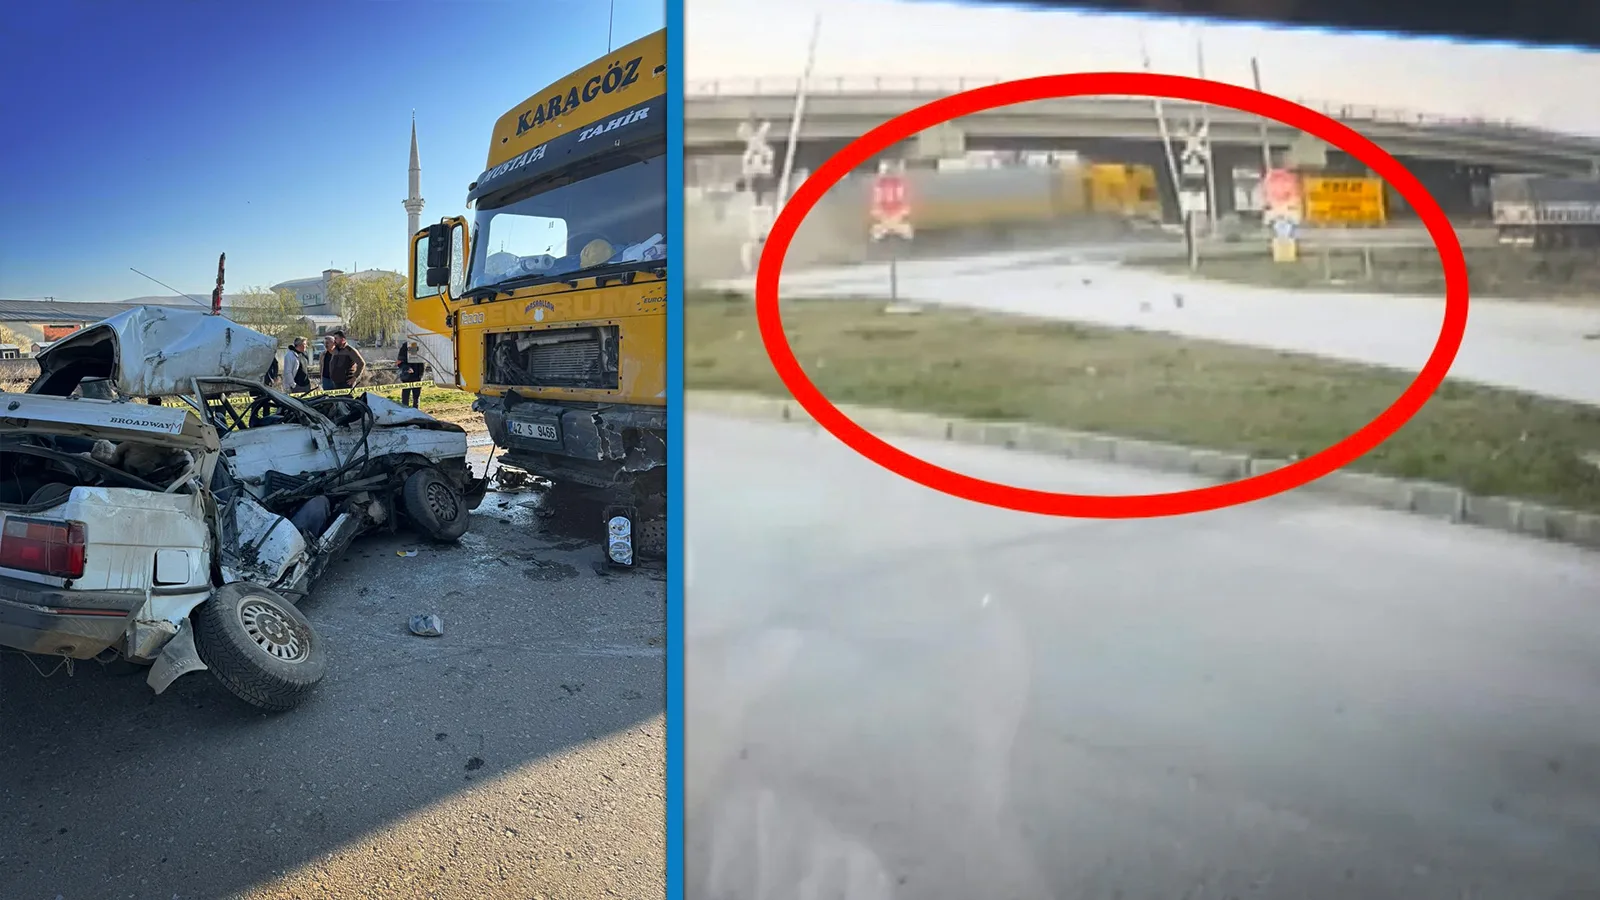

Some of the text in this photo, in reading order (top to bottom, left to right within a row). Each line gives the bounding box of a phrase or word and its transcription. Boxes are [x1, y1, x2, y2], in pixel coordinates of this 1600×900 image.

[516, 56, 643, 137] KARAGÖZ
[480, 107, 650, 185] MUSTAFA TAHİR
[110, 416, 171, 430] BROADWAY
[513, 422, 556, 439] 42 S 9466
